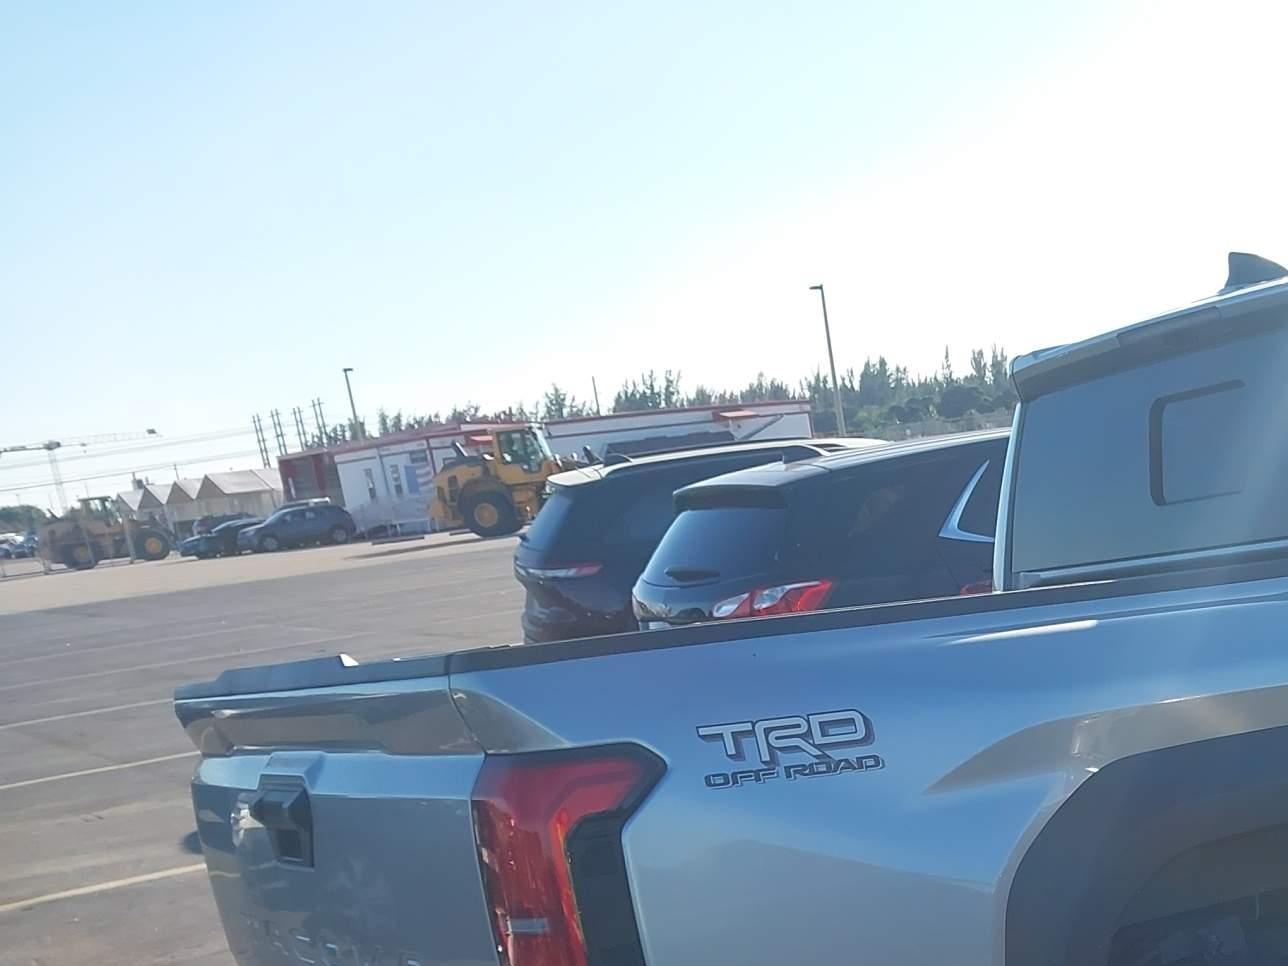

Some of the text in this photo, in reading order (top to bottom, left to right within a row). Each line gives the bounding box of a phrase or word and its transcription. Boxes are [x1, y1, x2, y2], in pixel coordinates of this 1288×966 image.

[696, 707, 872, 763] TRD
[704, 755, 885, 788] OFF ROAD
